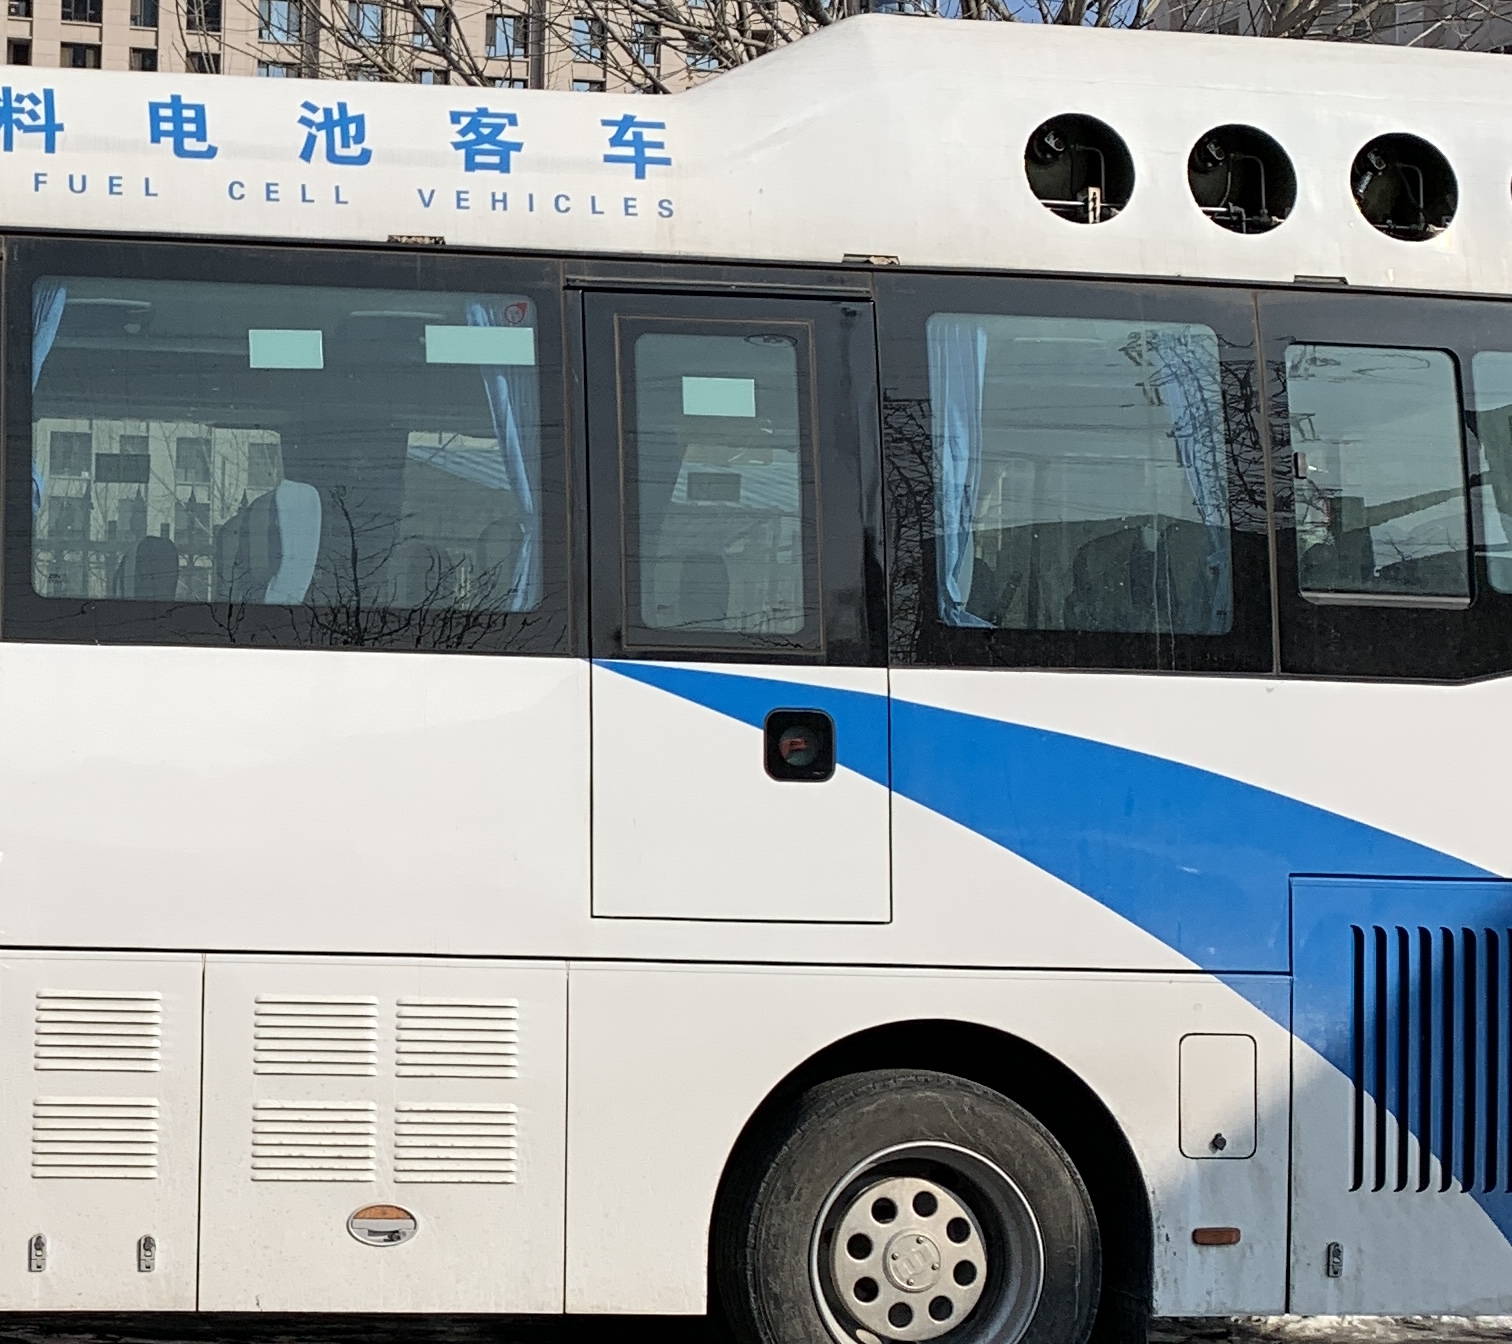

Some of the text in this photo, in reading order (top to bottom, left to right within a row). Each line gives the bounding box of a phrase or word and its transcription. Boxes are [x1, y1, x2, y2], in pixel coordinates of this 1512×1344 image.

[33, 172, 159, 198] FUEL
[228, 180, 350, 207] CELL
[417, 188, 675, 219] VEHICLES
